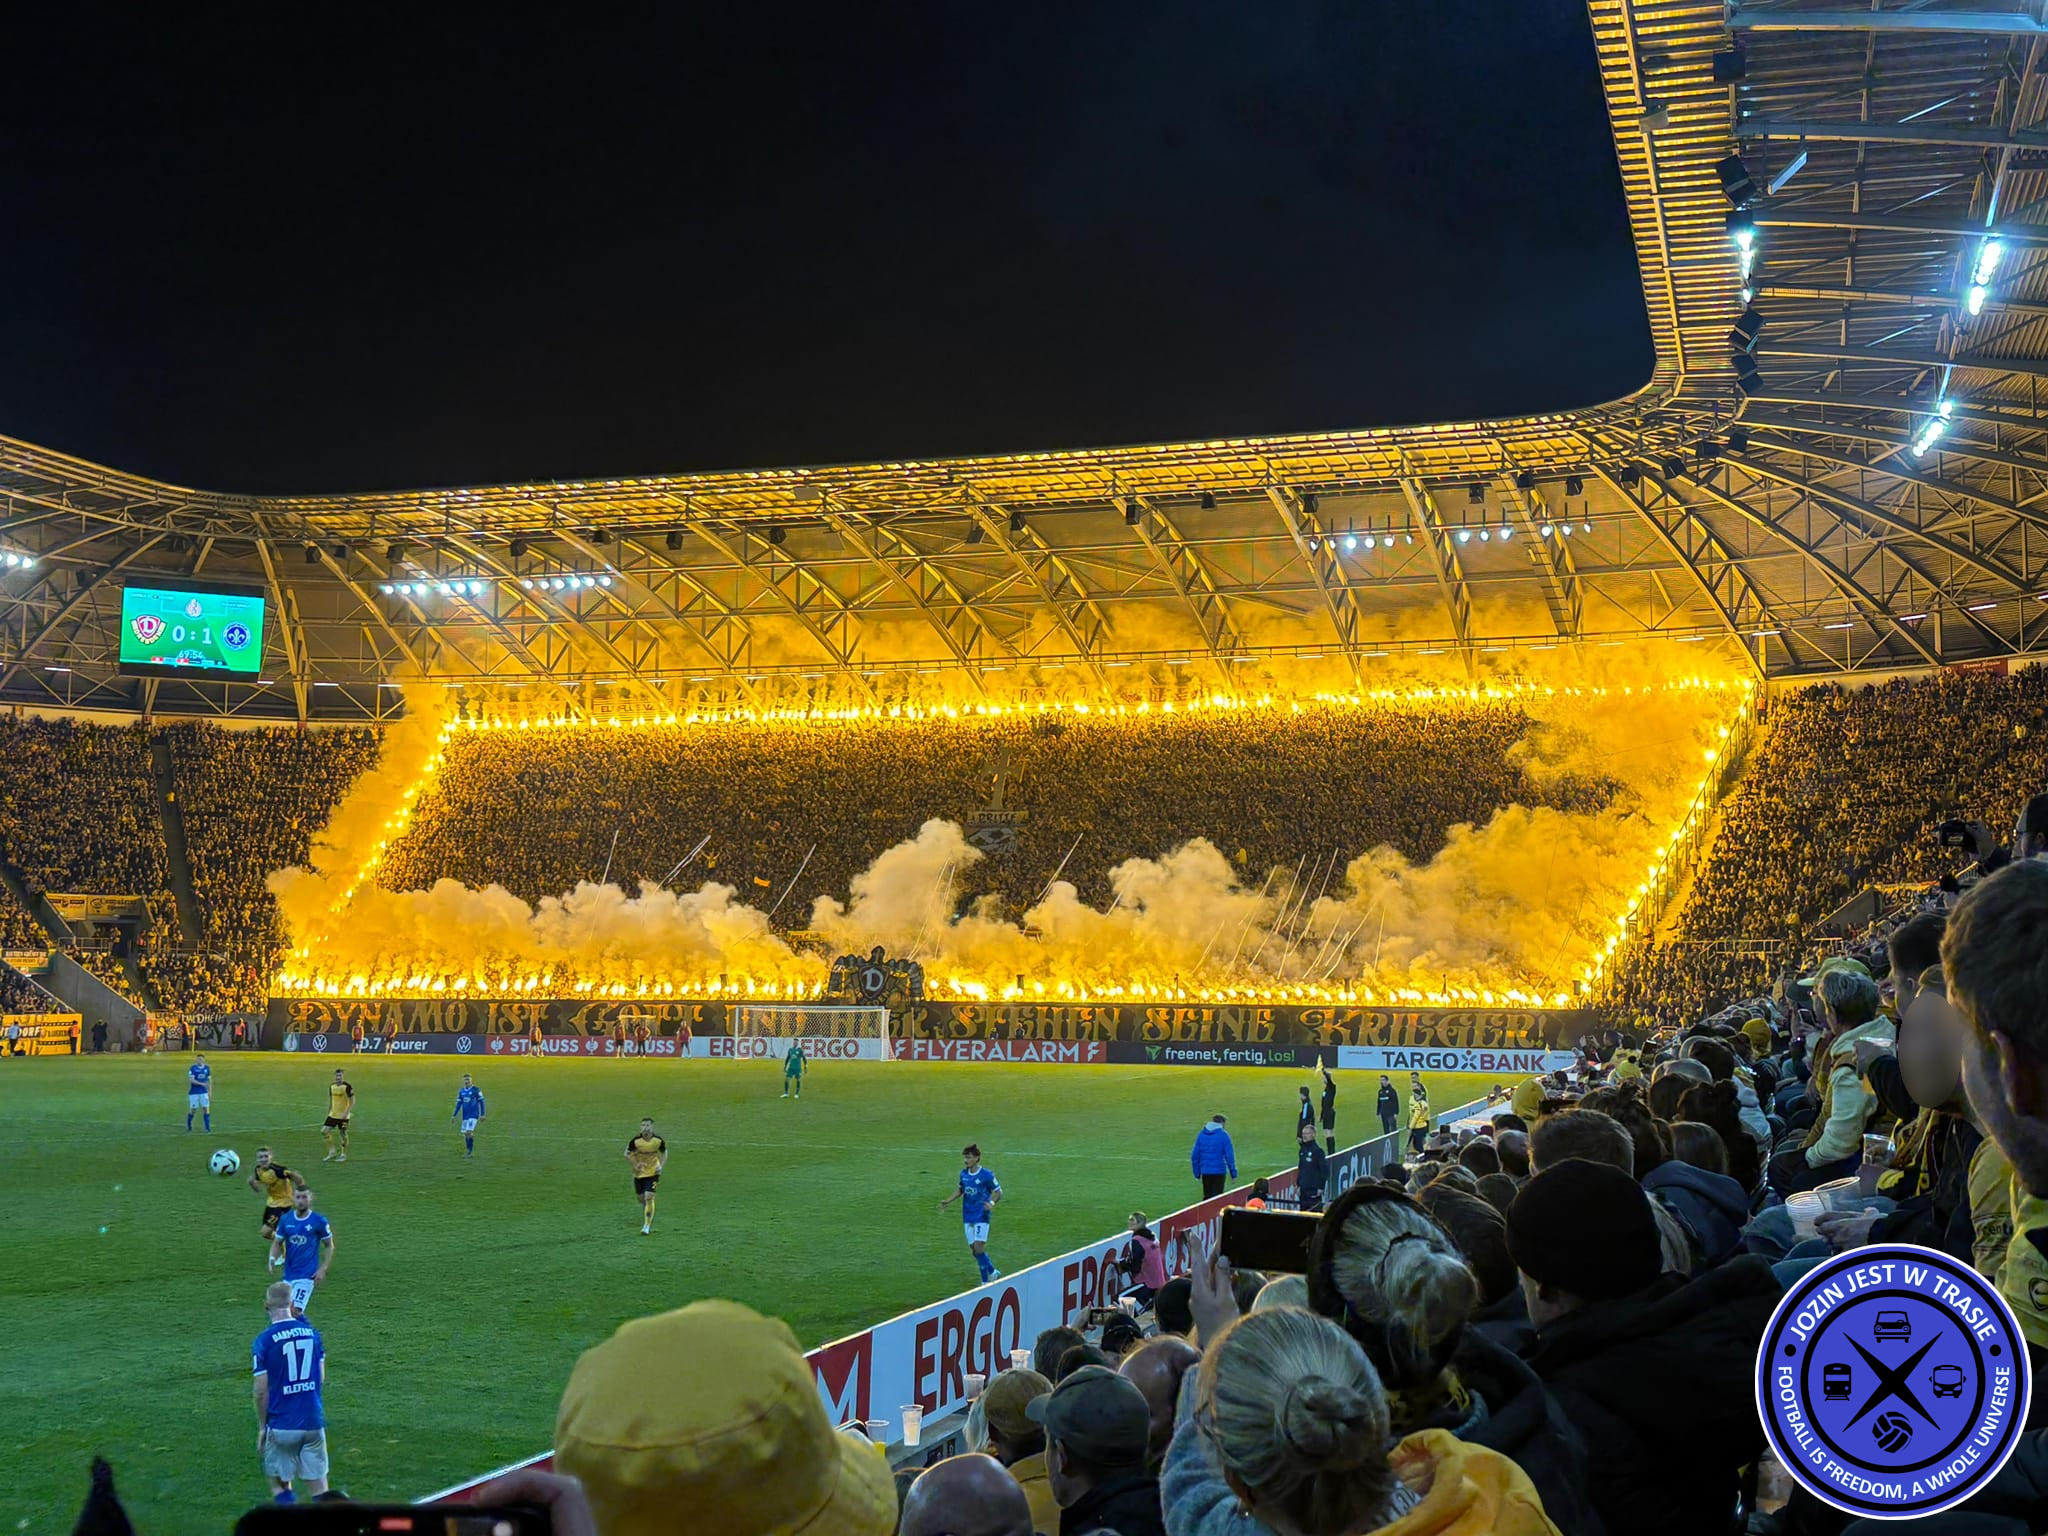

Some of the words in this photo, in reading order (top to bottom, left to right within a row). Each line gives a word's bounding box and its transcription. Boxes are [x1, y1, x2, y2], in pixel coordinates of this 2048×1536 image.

[172, 625, 186, 643] 0
[202, 627, 212, 645] 1
[287, 1001, 468, 1034] DYNAMO
[487, 1002, 549, 1034] IST
[1141, 1006, 1275, 1043] SEINE
[356, 1037, 381, 1050] D.7
[384, 1037, 428, 1050] ourer
[709, 1038, 767, 1058] ERGO
[801, 1038, 860, 1058] ERGO
[913, 1040, 1080, 1062] FLYERALARM
[295, 1288, 307, 1300] 15
[282, 1338, 314, 1382] 17
[913, 1286, 1021, 1418] ERGO
